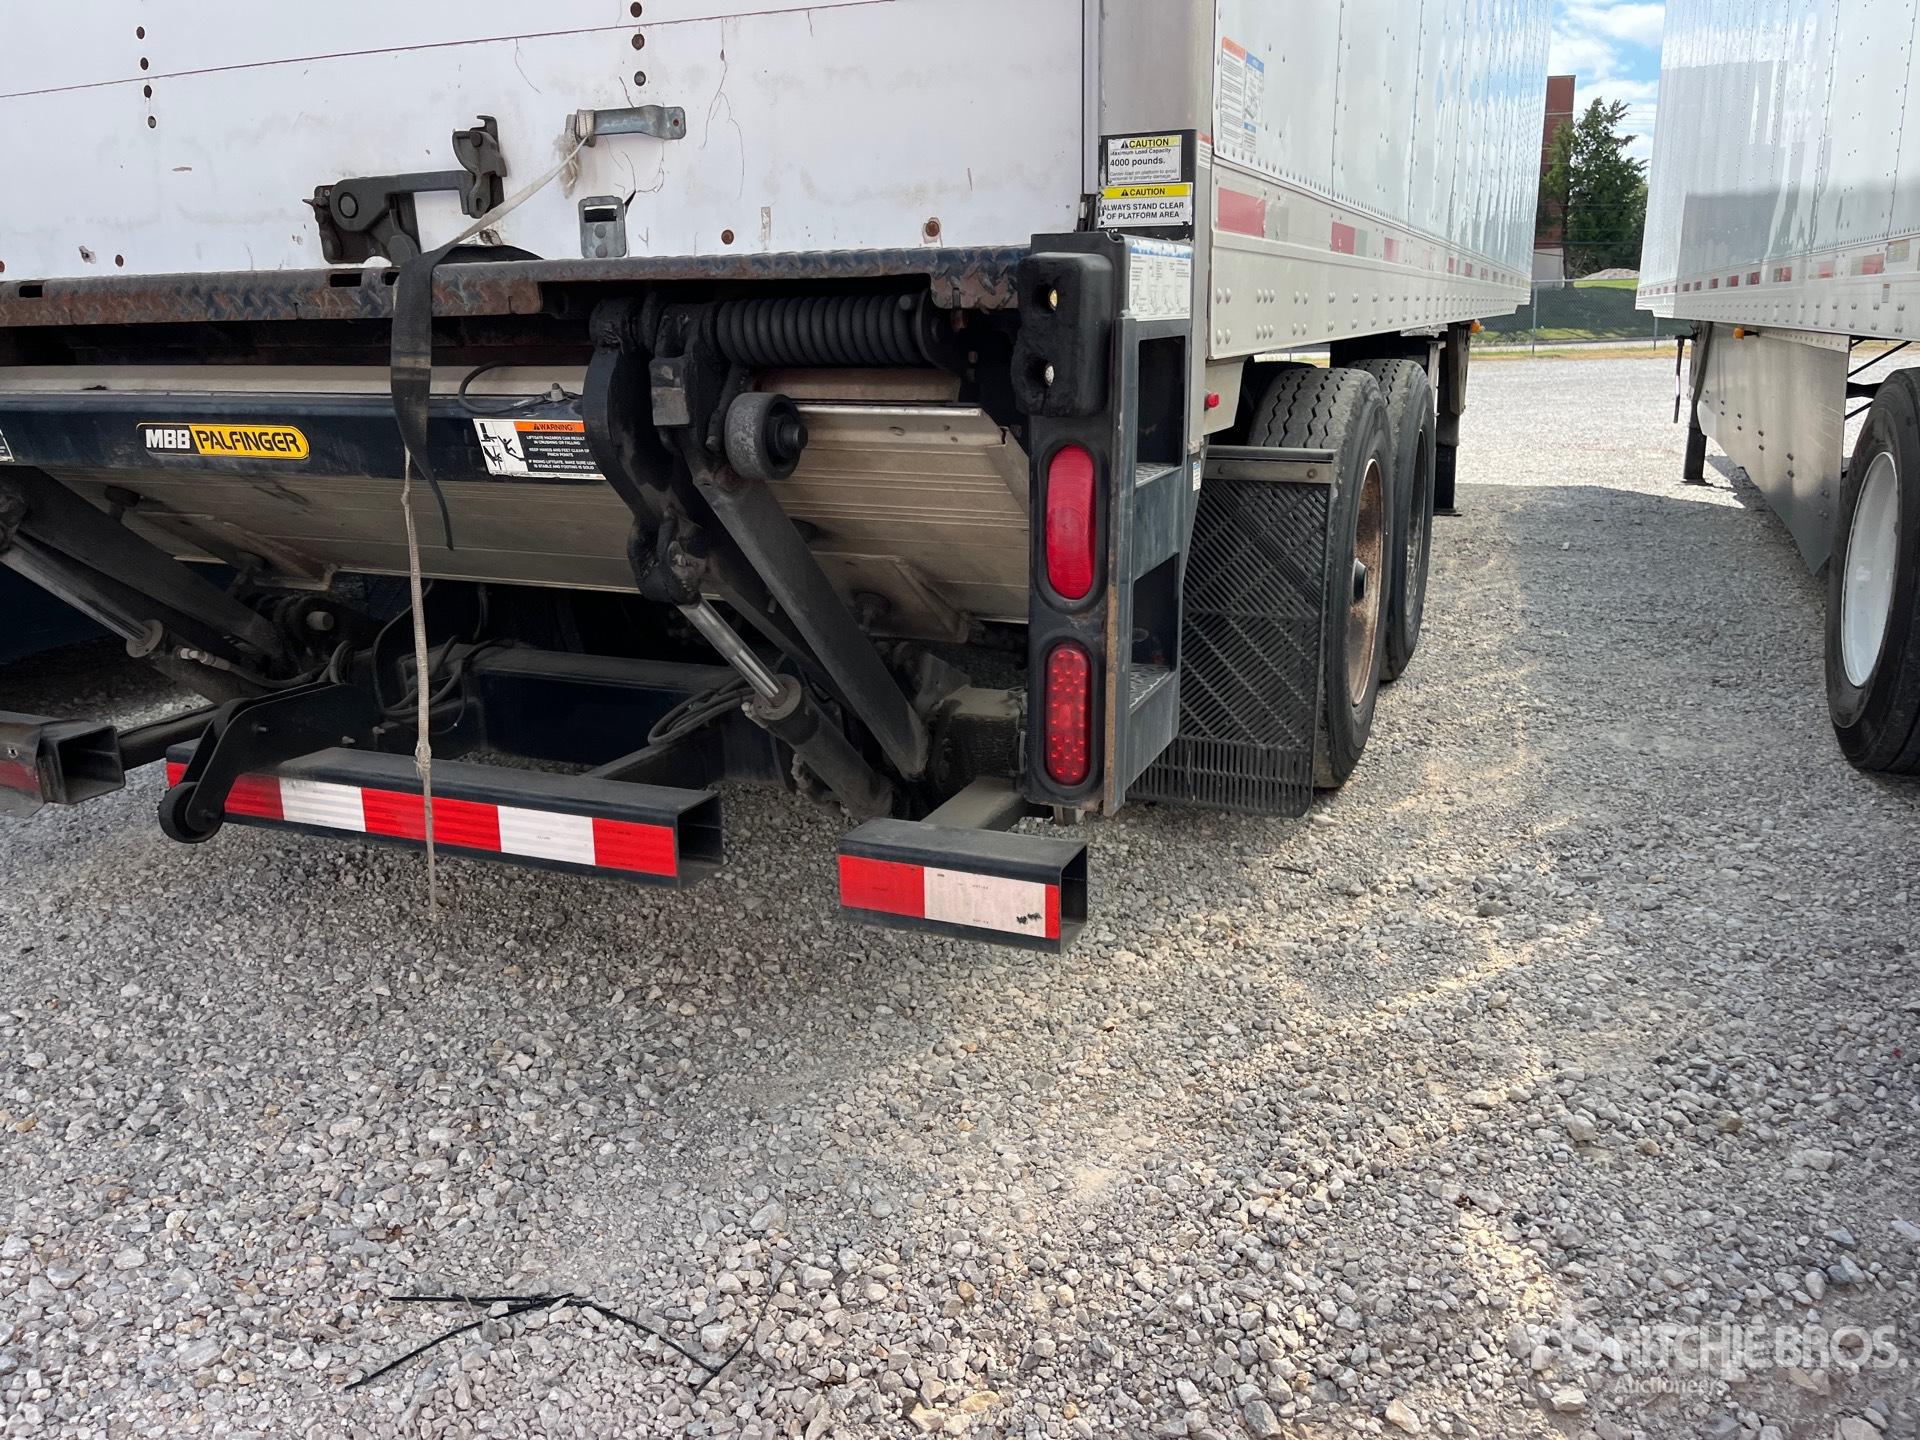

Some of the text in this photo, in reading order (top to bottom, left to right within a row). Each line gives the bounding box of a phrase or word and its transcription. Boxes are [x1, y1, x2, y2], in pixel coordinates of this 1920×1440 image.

[1129, 138, 1169, 148] CAUTION
[1110, 156, 1166, 168] 4000 pounds.
[1129, 188, 1166, 196] CAUTION
[1101, 203, 1131, 211] ALWAYS
[145, 429, 302, 453] MBB PALFINGER
